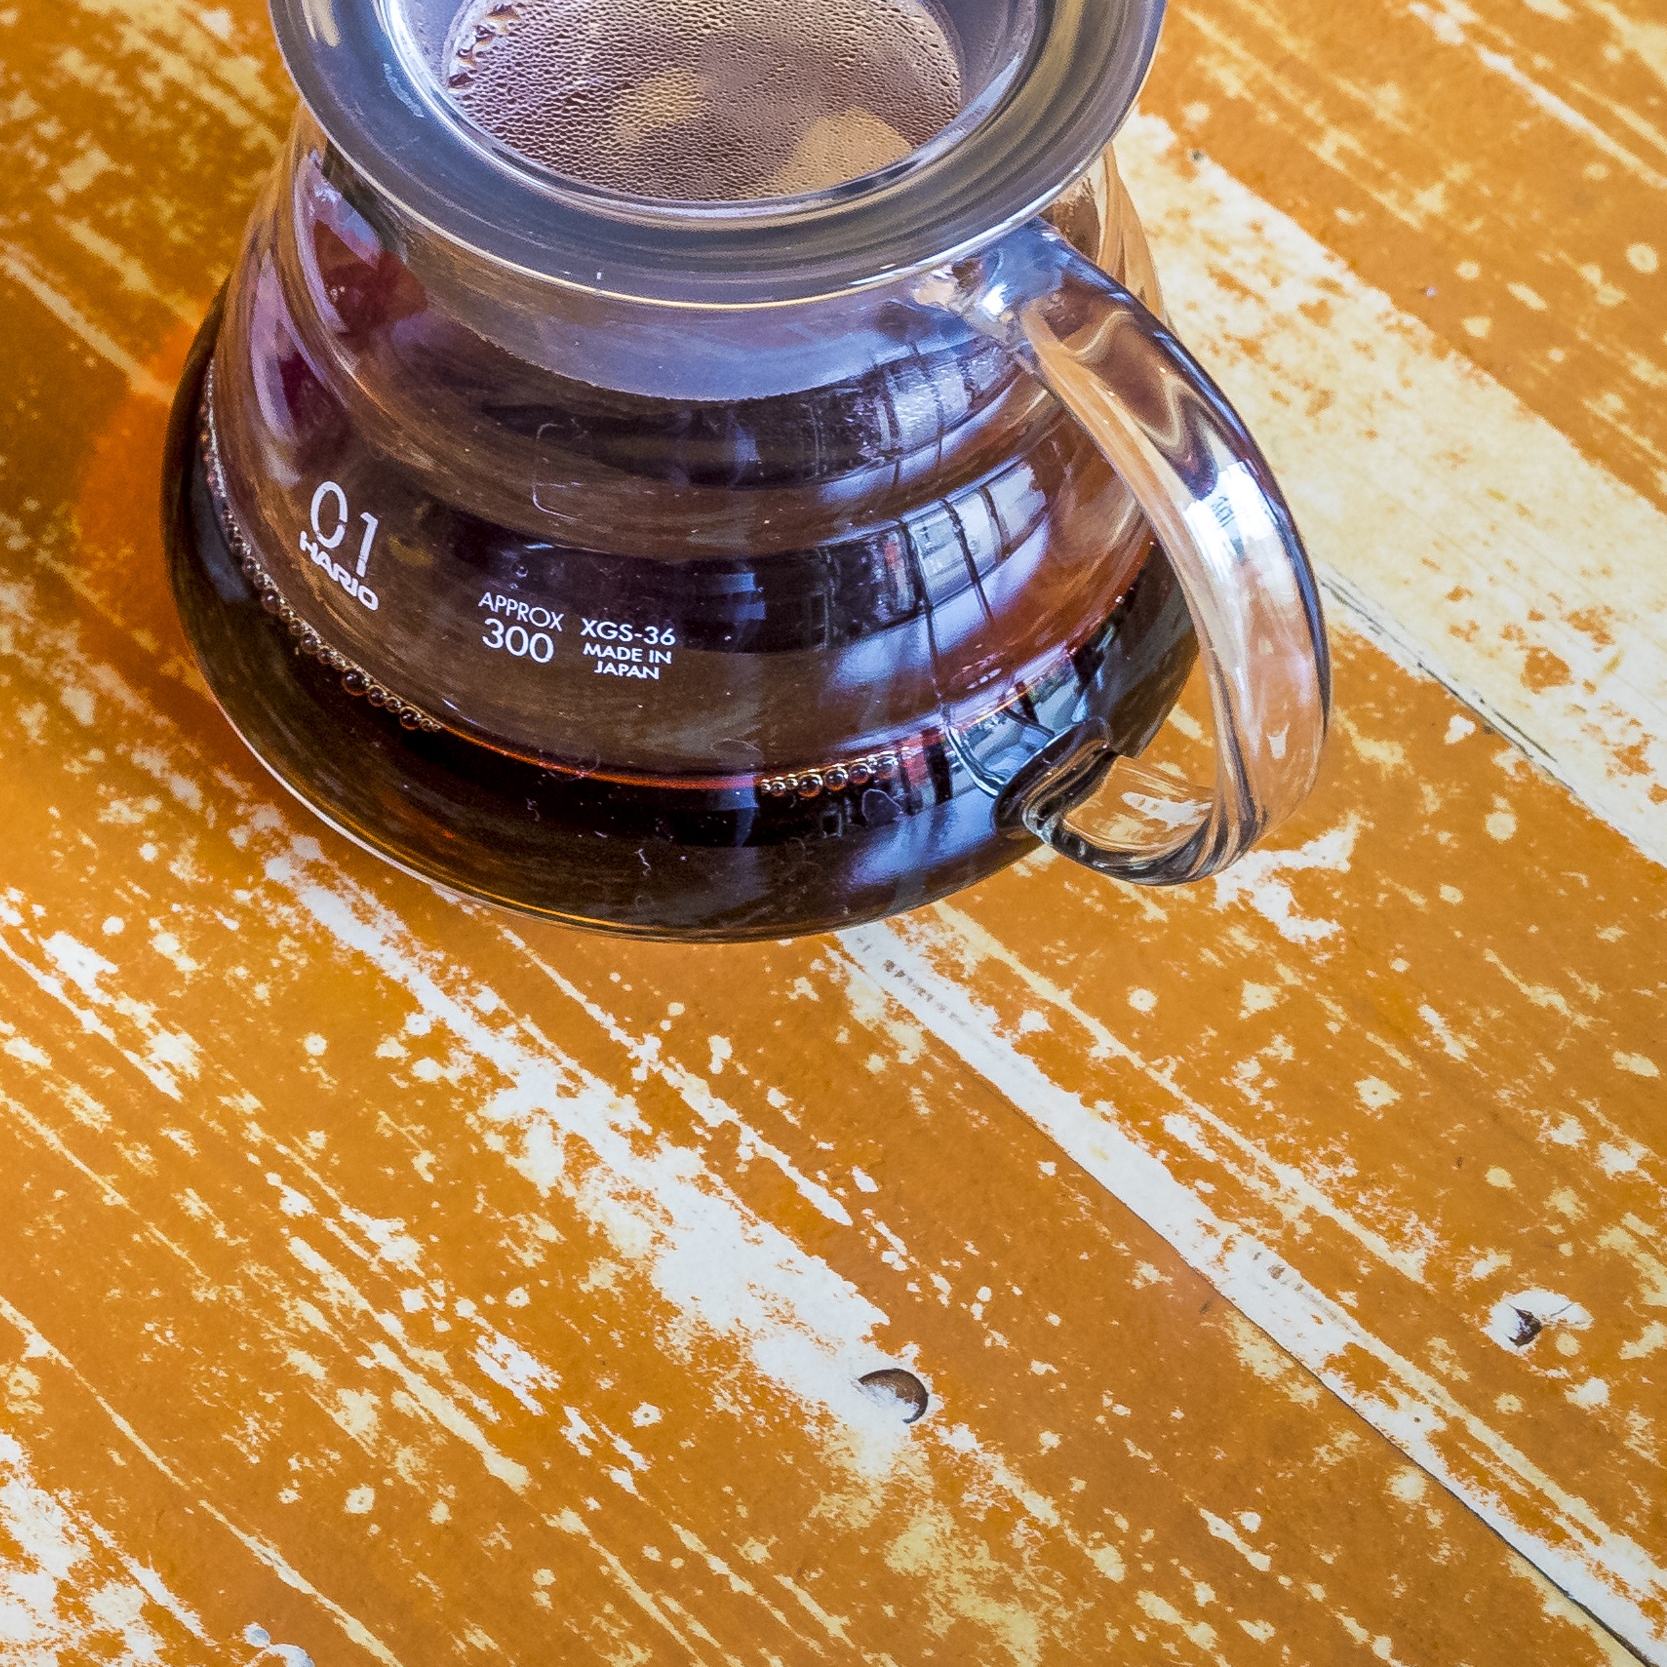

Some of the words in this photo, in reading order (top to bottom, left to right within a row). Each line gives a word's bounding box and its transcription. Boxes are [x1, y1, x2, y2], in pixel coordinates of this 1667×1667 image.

[310, 481, 379, 577] 01
[299, 530, 379, 610] HARIO
[478, 591, 565, 631] APPROX
[482, 618, 555, 664] 300
[580, 618, 676, 646] XGS-36
[582, 642, 643, 663] MADE
[649, 647, 672, 665] IN
[594, 660, 661, 680] JAPAN
